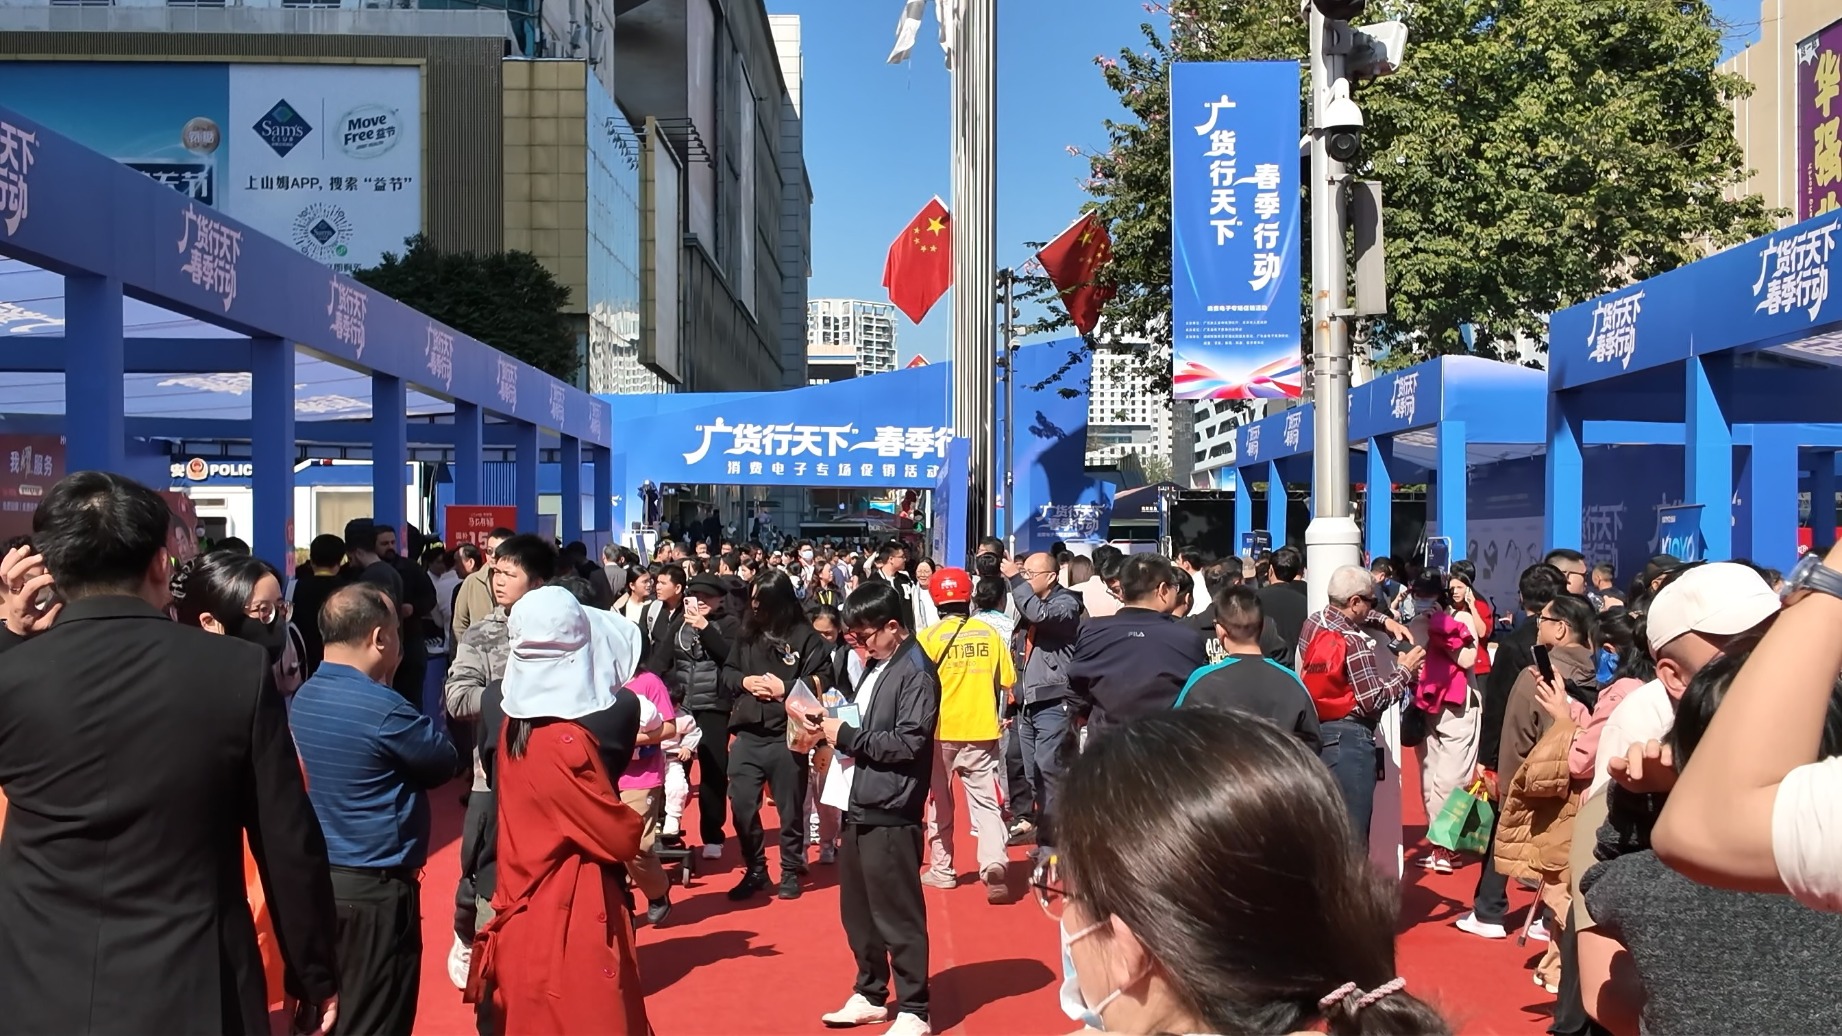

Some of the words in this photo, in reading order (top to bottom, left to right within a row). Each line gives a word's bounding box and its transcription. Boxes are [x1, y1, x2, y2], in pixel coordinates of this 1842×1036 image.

[261, 120, 303, 137] Sam's
[344, 130, 374, 146] Free
[376, 126, 396, 140] 益节
[347, 115, 386, 131] Move
[1233, 163, 1280, 291] 春季行动
[181, 249, 237, 312] 春季行动
[1754, 265, 1829, 322] 春季行动
[330, 311, 365, 360] 春季行动
[1588, 325, 1636, 370] 春季行动
